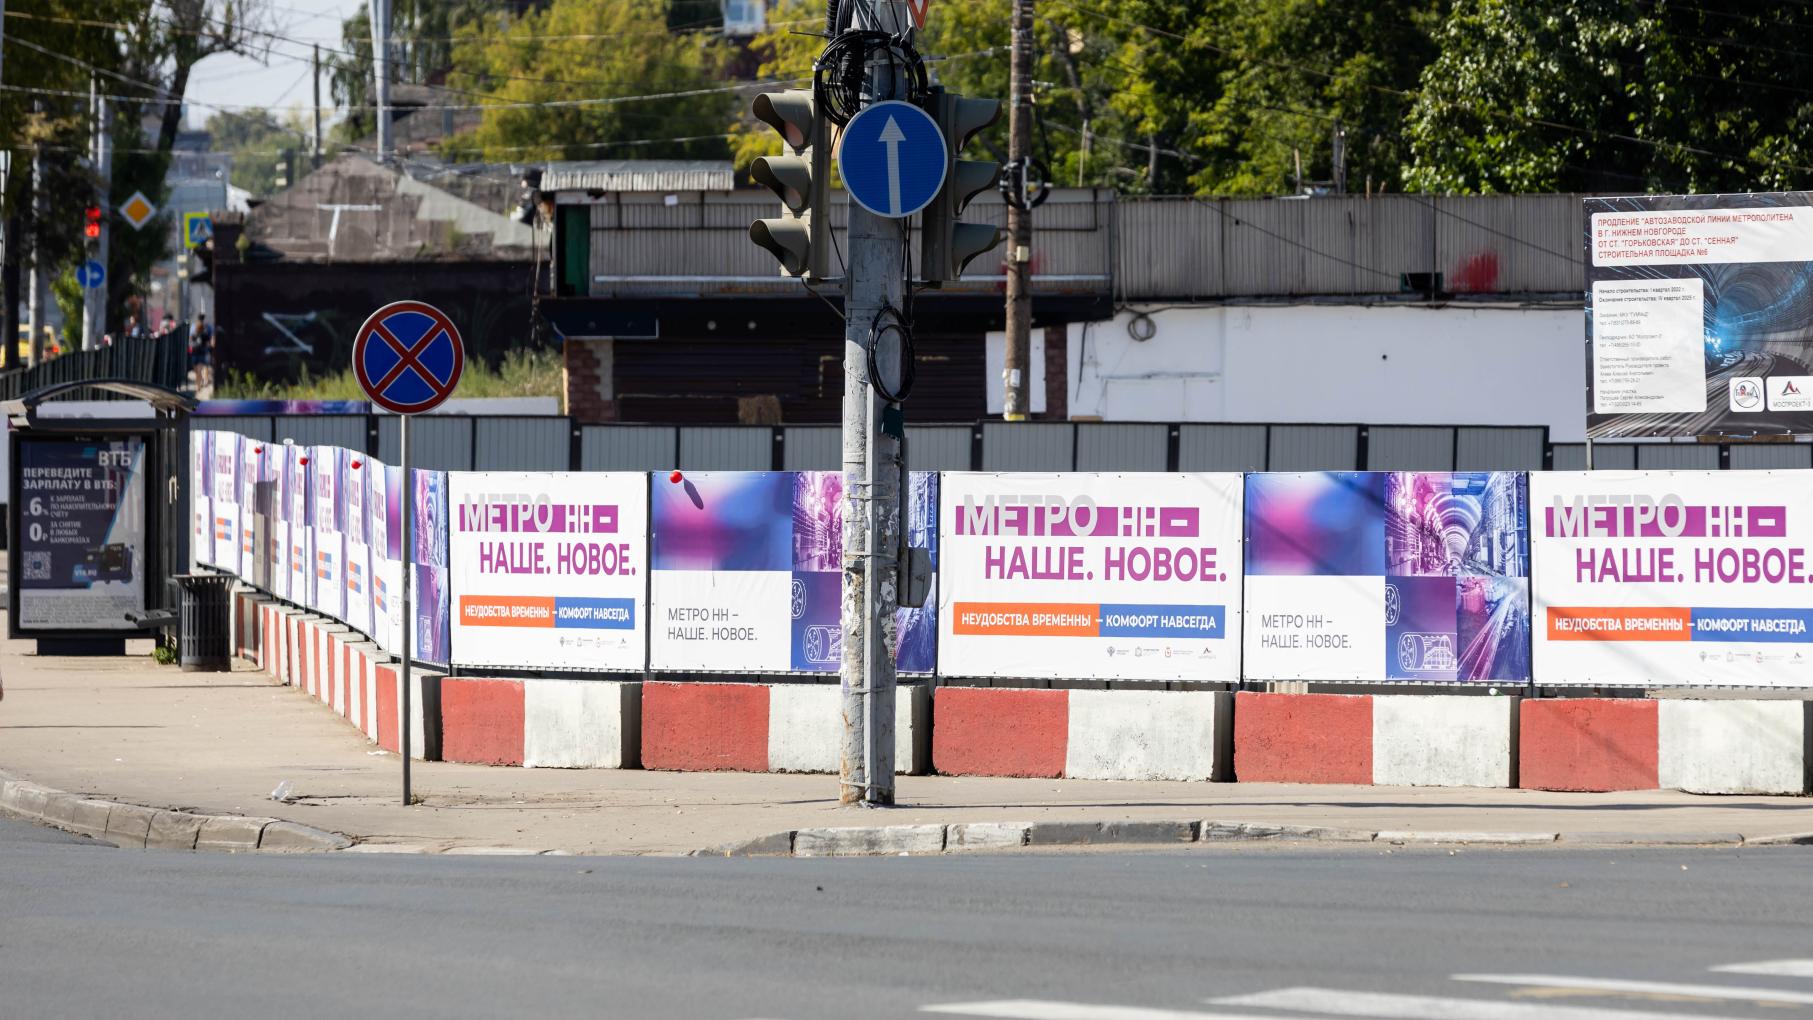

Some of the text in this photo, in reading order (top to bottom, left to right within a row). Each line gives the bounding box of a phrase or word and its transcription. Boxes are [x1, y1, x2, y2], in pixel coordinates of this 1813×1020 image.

[1598, 218, 1640, 227] ПРОДЛЕНИЕ
[1707, 215, 1731, 224] ЛИНИИ
[1732, 213, 1794, 222] МЕТРОПОЛИТЕНА
[1598, 230, 1604, 238] В
[1612, 228, 1642, 237] НИЖНЕМ
[1644, 227, 1686, 236] НОВГОРОДЕ
[1598, 240, 1608, 248] ОТ
[1680, 238, 1690, 246] ДО
[1598, 249, 1654, 258] СТРОИТЕЛЬНАЯ
[1655, 248, 1695, 257] ПЛОЩАДКА
[98, 450, 132, 466] ВТБ
[23, 468, 93, 479] ПЕРЕВЕДИТЕ
[23, 480, 82, 490] ЗАРПЛАТУ
[84, 480, 91, 490] В
[464, 493, 554, 532] МЕТРО
[963, 494, 1098, 537] МЕТРО
[1553, 493, 1687, 538] МЕТРО
[480, 542, 636, 576] НАШЕ. НОВОЕ.
[985, 546, 1227, 582] НАШЕ. НОВОЕ.
[1576, 548, 1684, 583] НАШЕ.
[464, 604, 510, 618] НЕУДОБСТВА
[512, 606, 550, 618] ВРЕМЕННЫ
[558, 608, 593, 620] КОМФОРТ
[594, 608, 630, 622] НАВСЕГДА
[668, 608, 709, 621] МЕТРО
[712, 608, 729, 621] НН
[962, 612, 1030, 627] НЕУДОБСТВА
[1032, 614, 1091, 626] ВРЕМЕННЫ
[1106, 614, 1158, 628] КОМФОРТ
[1161, 615, 1217, 630] НАВСЕГДА
[1261, 614, 1304, 628] МЕТРО
[1306, 614, 1323, 628] НН
[1555, 618, 1622, 632] НЕУДОБСТВА
[1624, 619, 1683, 632] ВРЕМЕННЫ
[1697, 619, 1748, 633] КОМФОРТ
[1751, 620, 1806, 634] НАВСЕГДА
[668, 626, 758, 640] НАШЕ. НОВОЕ.
[1261, 634, 1352, 648] НАШЕ. НОВОЕ.
